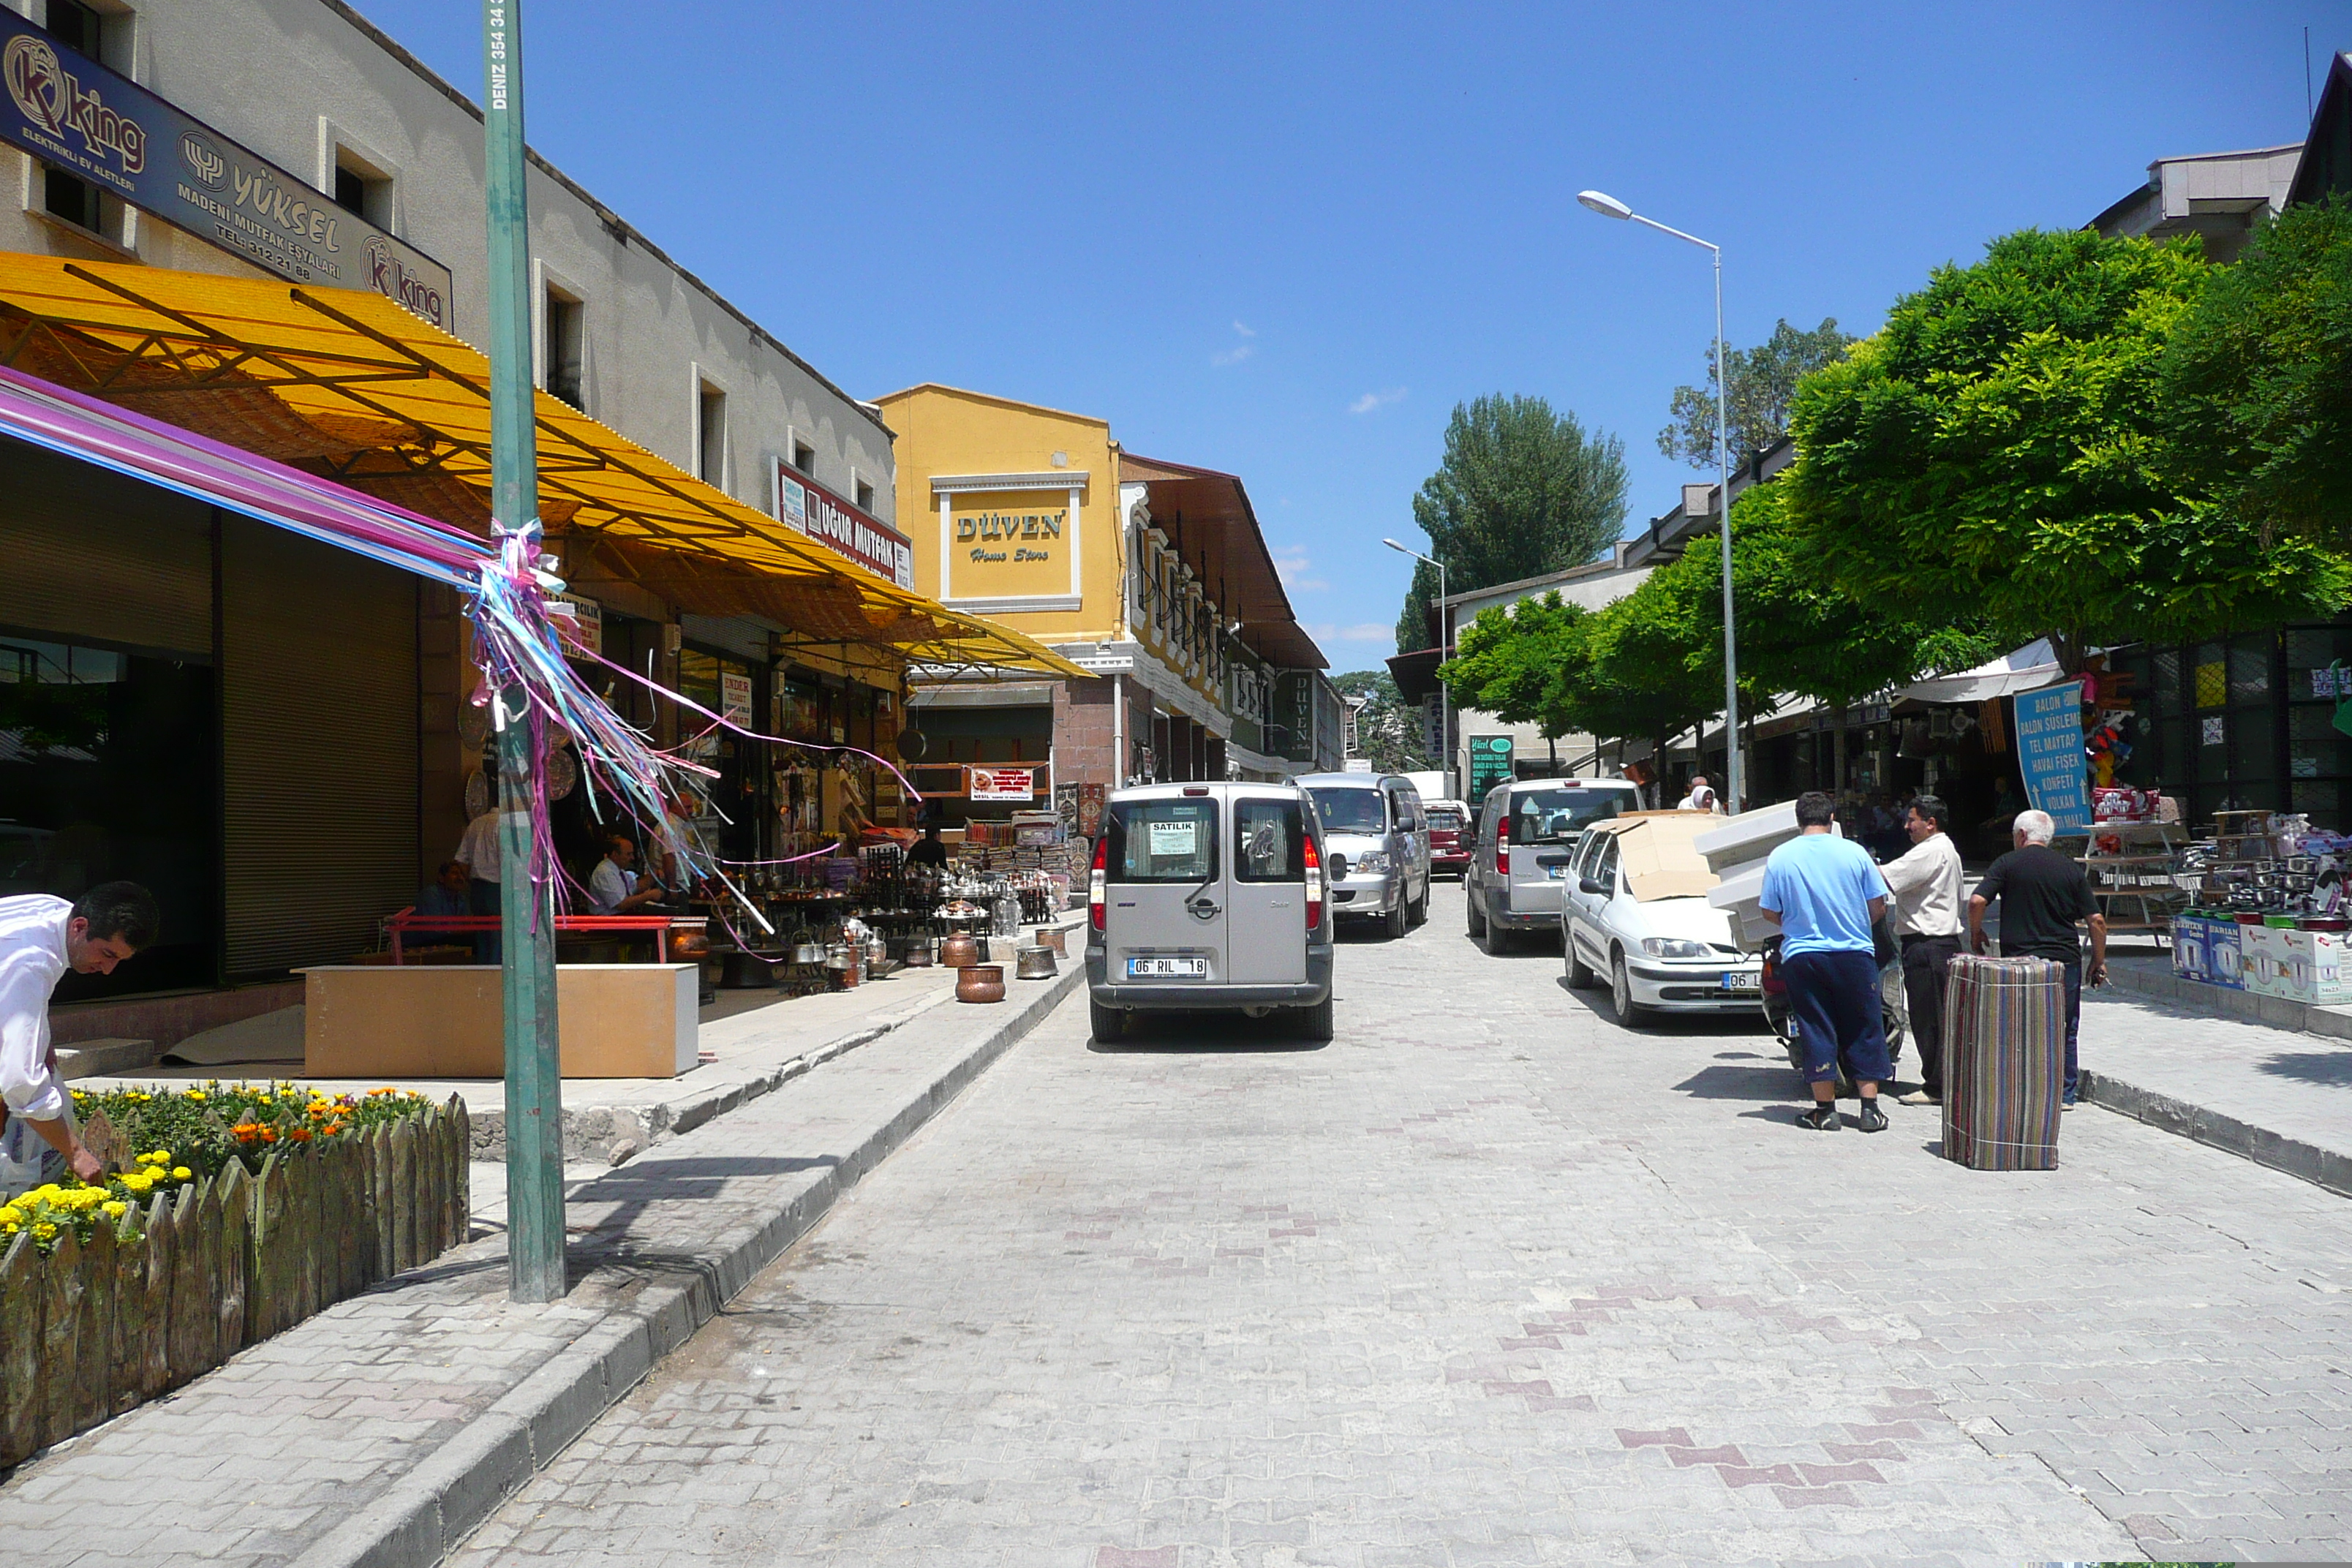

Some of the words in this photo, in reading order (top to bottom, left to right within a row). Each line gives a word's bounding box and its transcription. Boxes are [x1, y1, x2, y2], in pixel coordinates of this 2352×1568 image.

[490, 7, 504, 27] 34
[491, 31, 505, 60] 354
[64, 71, 146, 175] king
[80, 157, 91, 169] EV
[94, 165, 135, 192] ALETLERİ
[234, 165, 339, 252] YÜKSEL
[177, 182, 231, 223] MADENİ
[234, 212, 285, 251] MUTFAK
[287, 240, 342, 280] EŞYALARI
[214, 222, 246, 248] TEL:
[249, 241, 274, 264] 312
[276, 255, 291, 272] 21
[295, 265, 312, 281] 88
[821, 500, 853, 546] UĞUR
[854, 521, 894, 568] MUTFAK
[957, 512, 1062, 539] DÜVEN
[970, 547, 1007, 563] Home
[1014, 547, 1049, 562] Store
[724, 677, 750, 693] ENDER
[2035, 696, 2061, 713] BALON
[2020, 718, 2043, 736] BALON
[2029, 739, 2043, 753] TEL
[2043, 733, 2076, 752] MAYTAP
[2055, 752, 2080, 772] FİŞEK
[2041, 771, 2074, 791] KONFETİ
[2046, 794, 2076, 810] VOLKAN
[1153, 823, 1192, 831] SATILIK
[1554, 866, 1564, 875] 06
[1136, 960, 1149, 973] 06
[1157, 960, 1175, 973] RIL
[1730, 975, 1746, 987] 06
